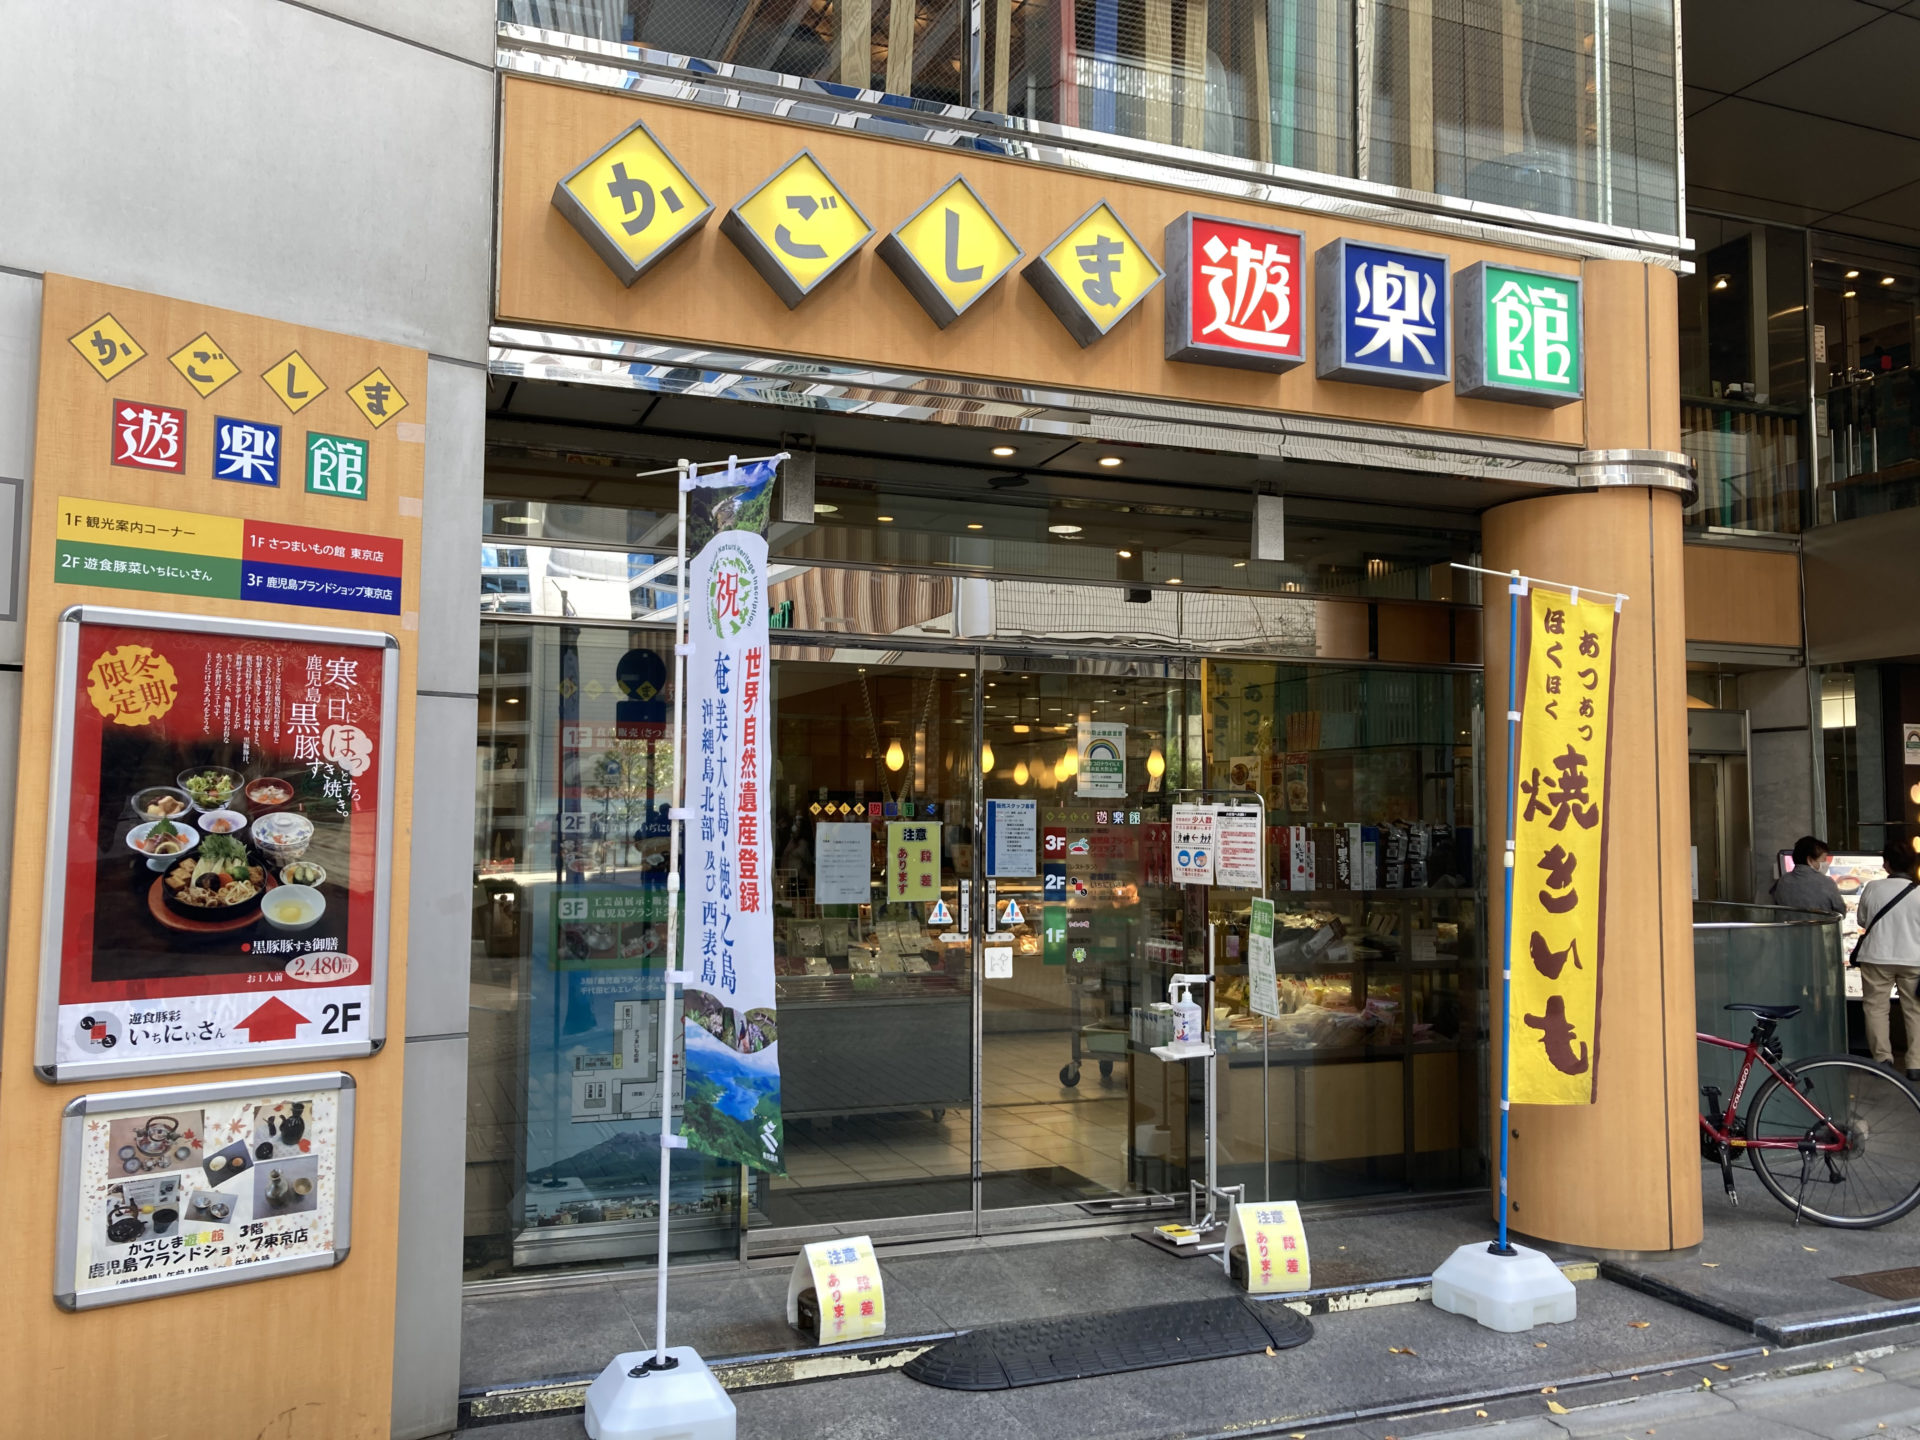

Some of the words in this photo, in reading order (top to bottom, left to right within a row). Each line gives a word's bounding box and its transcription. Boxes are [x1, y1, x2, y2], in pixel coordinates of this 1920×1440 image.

[91, 329, 391, 417] かごしま
[117, 407, 364, 495] 遊楽館
[64, 512, 82, 527] 1F
[86, 514, 196, 538] 観光案内コーナー
[249, 534, 265, 549] 1F
[268, 536, 346, 559] さつまいもの館
[350, 547, 384, 563] 東京店
[62, 553, 81, 570] 2F
[84, 555, 213, 583] 遊食豚菜いちにいさん
[247, 572, 263, 587] 3F
[266, 575, 393, 601] 鹿児島ブランドショップ東京店
[716, 571, 740, 619] 祝
[1544, 607, 1566, 720] ほくほく
[1578, 630, 1600, 741] あつあつ
[738, 646, 762, 913] 世界自然遺産登録
[564, 816, 589, 830] 2F
[714, 651, 737, 995] 奄美大島・徳之島
[1192, 815, 1212, 824] 少人数
[903, 828, 928, 842] 注意
[1045, 835, 1066, 851] 3F
[897, 847, 908, 896] あります
[920, 849, 932, 888] 段差
[1045, 874, 1066, 890] 2F
[562, 902, 583, 916] 3F
[1520, 743, 1600, 1077] 焼きいも
[252, 936, 339, 955] 黒豚豚すき御膳
[1045, 927, 1065, 943] 1F
[294, 956, 352, 977] 2,480円
[128, 1010, 181, 1025] 遊食豚彩
[321, 1002, 361, 1035] 2F
[129, 1020, 226, 1046] いちにいさん
[1732, 1067, 1749, 1110] COLNAGO
[239, 1222, 264, 1239] 3階
[1257, 1210, 1285, 1224] 注意
[827, 1247, 858, 1265] 注意
[1256, 1231, 1272, 1286] あります
[1283, 1235, 1299, 1273] 段差
[828, 1273, 846, 1332] あります
